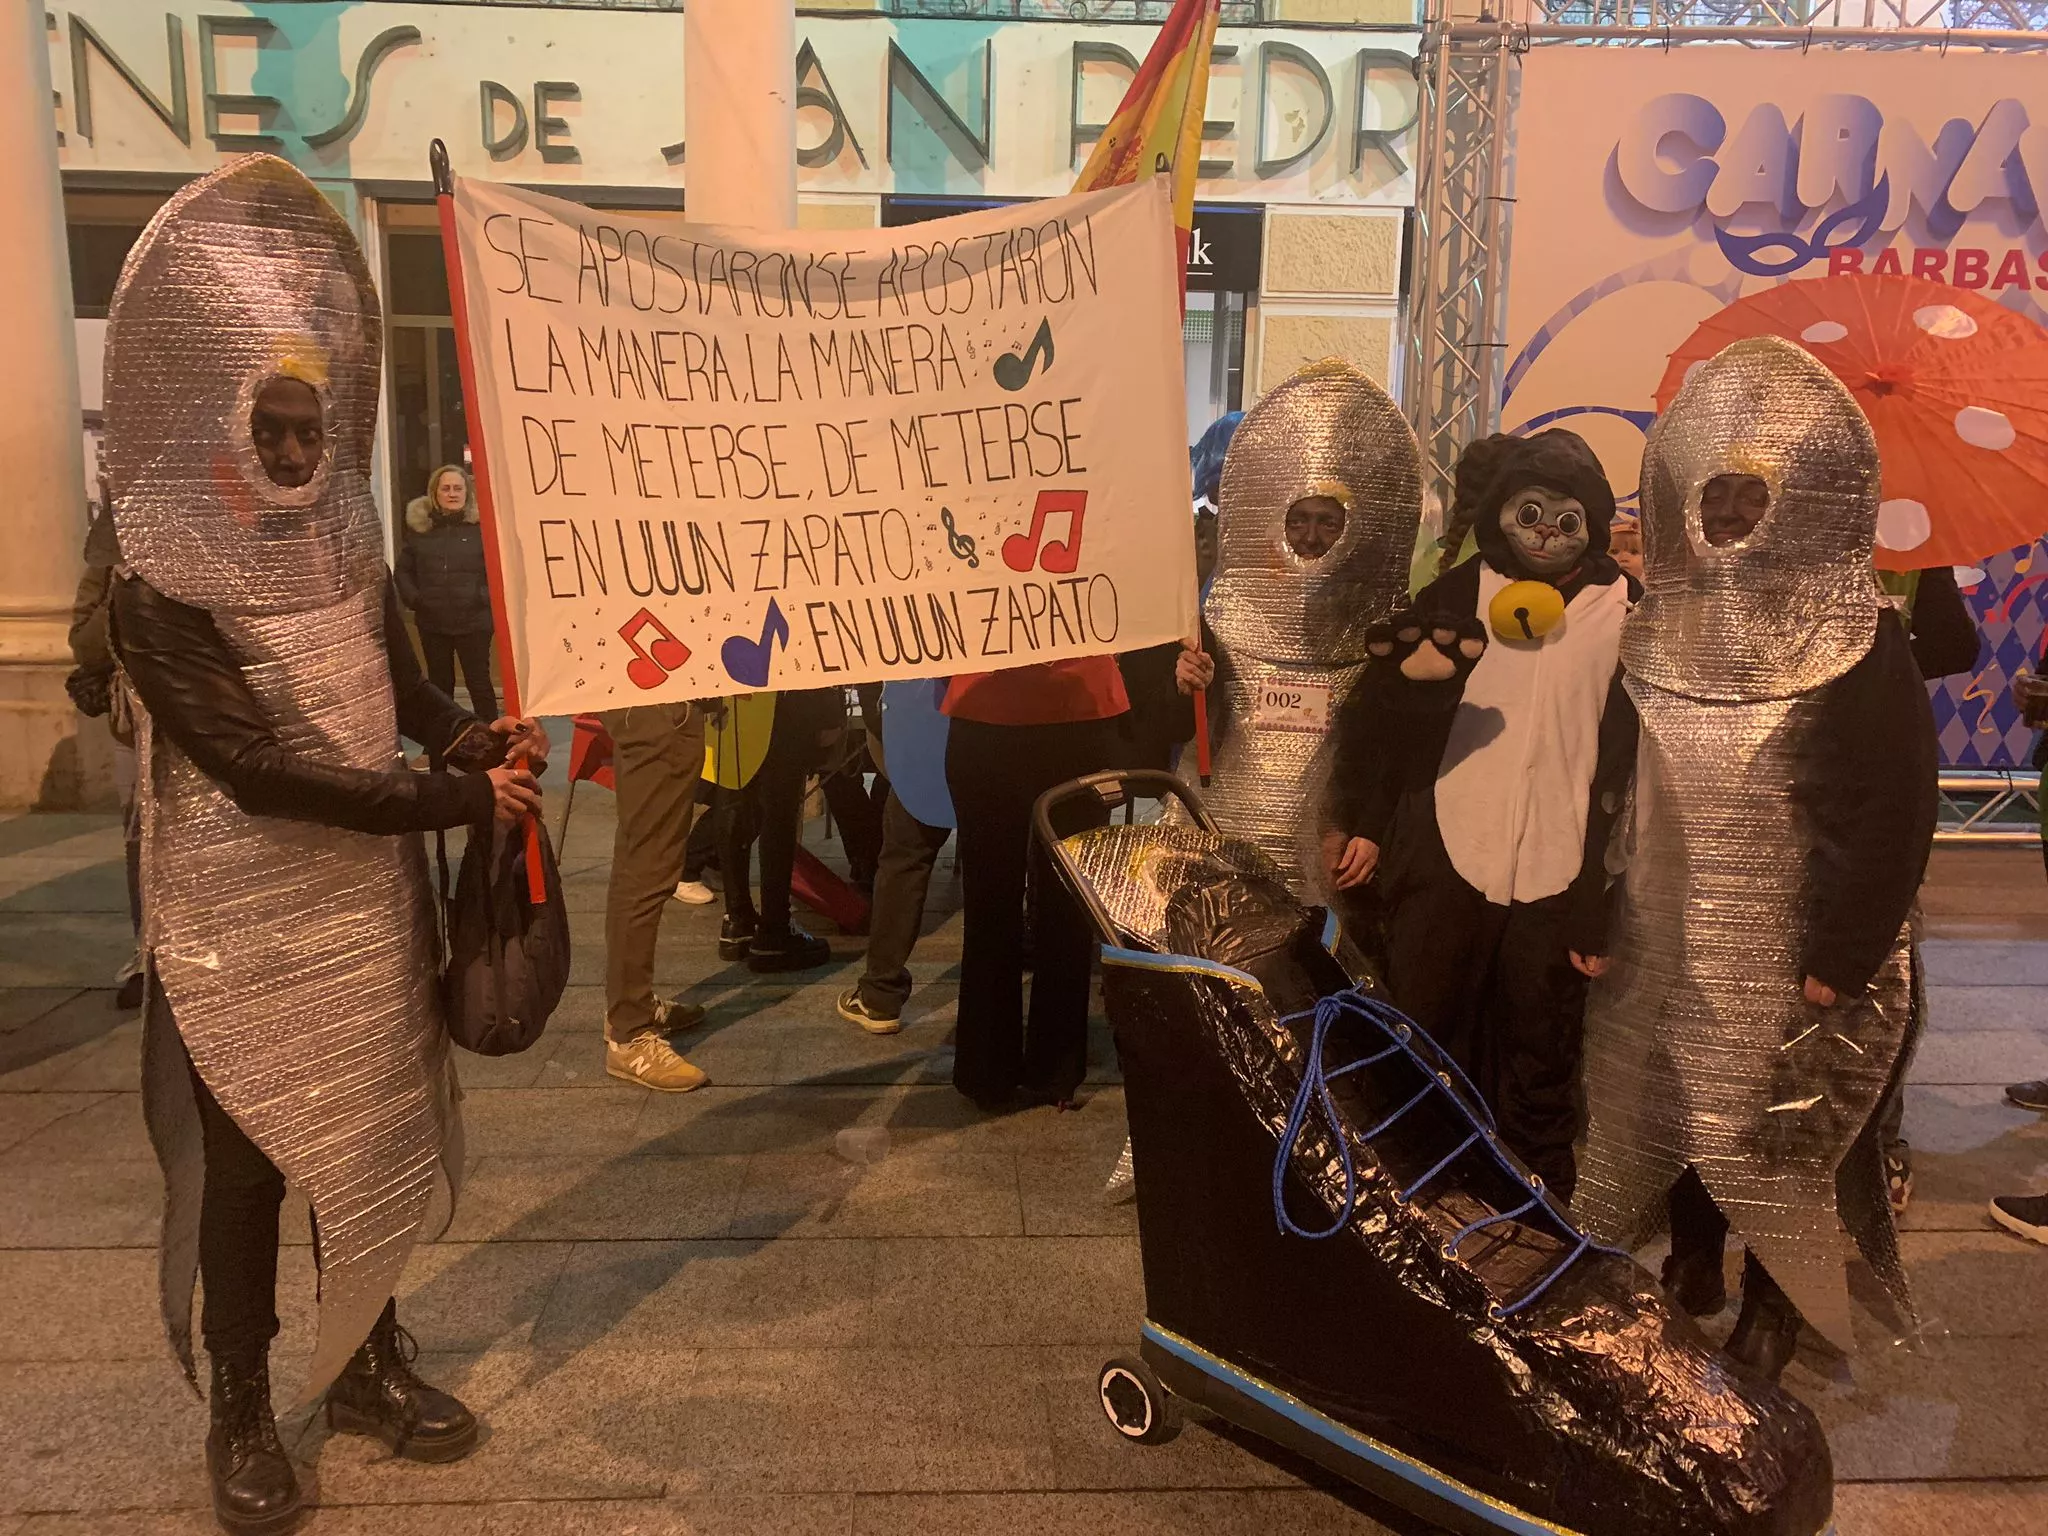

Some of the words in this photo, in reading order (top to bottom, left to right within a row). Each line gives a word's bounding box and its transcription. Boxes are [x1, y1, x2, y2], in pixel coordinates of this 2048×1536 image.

[46, 12, 421, 153] NES
[480, 80, 580, 163] DE
[484, 213, 562, 303] SE
[877, 214, 1098, 318] APOSTARON
[505, 318, 576, 395] LA
[745, 333, 803, 403] LA
[809, 322, 966, 399] MANERA
[521, 415, 587, 496] DE
[601, 423, 814, 501] METERSE,
[816, 420, 878, 497] DE
[889, 397, 1087, 490] METERSE
[539, 518, 608, 599] EN
[614, 518, 736, 598] UUUN
[740, 508, 920, 592] ZAPATO,
[805, 599, 868, 674] EN
[865, 590, 968, 666] UUUN
[966, 573, 1119, 657] ZAPATO
[1265, 691, 1302, 709] 002
